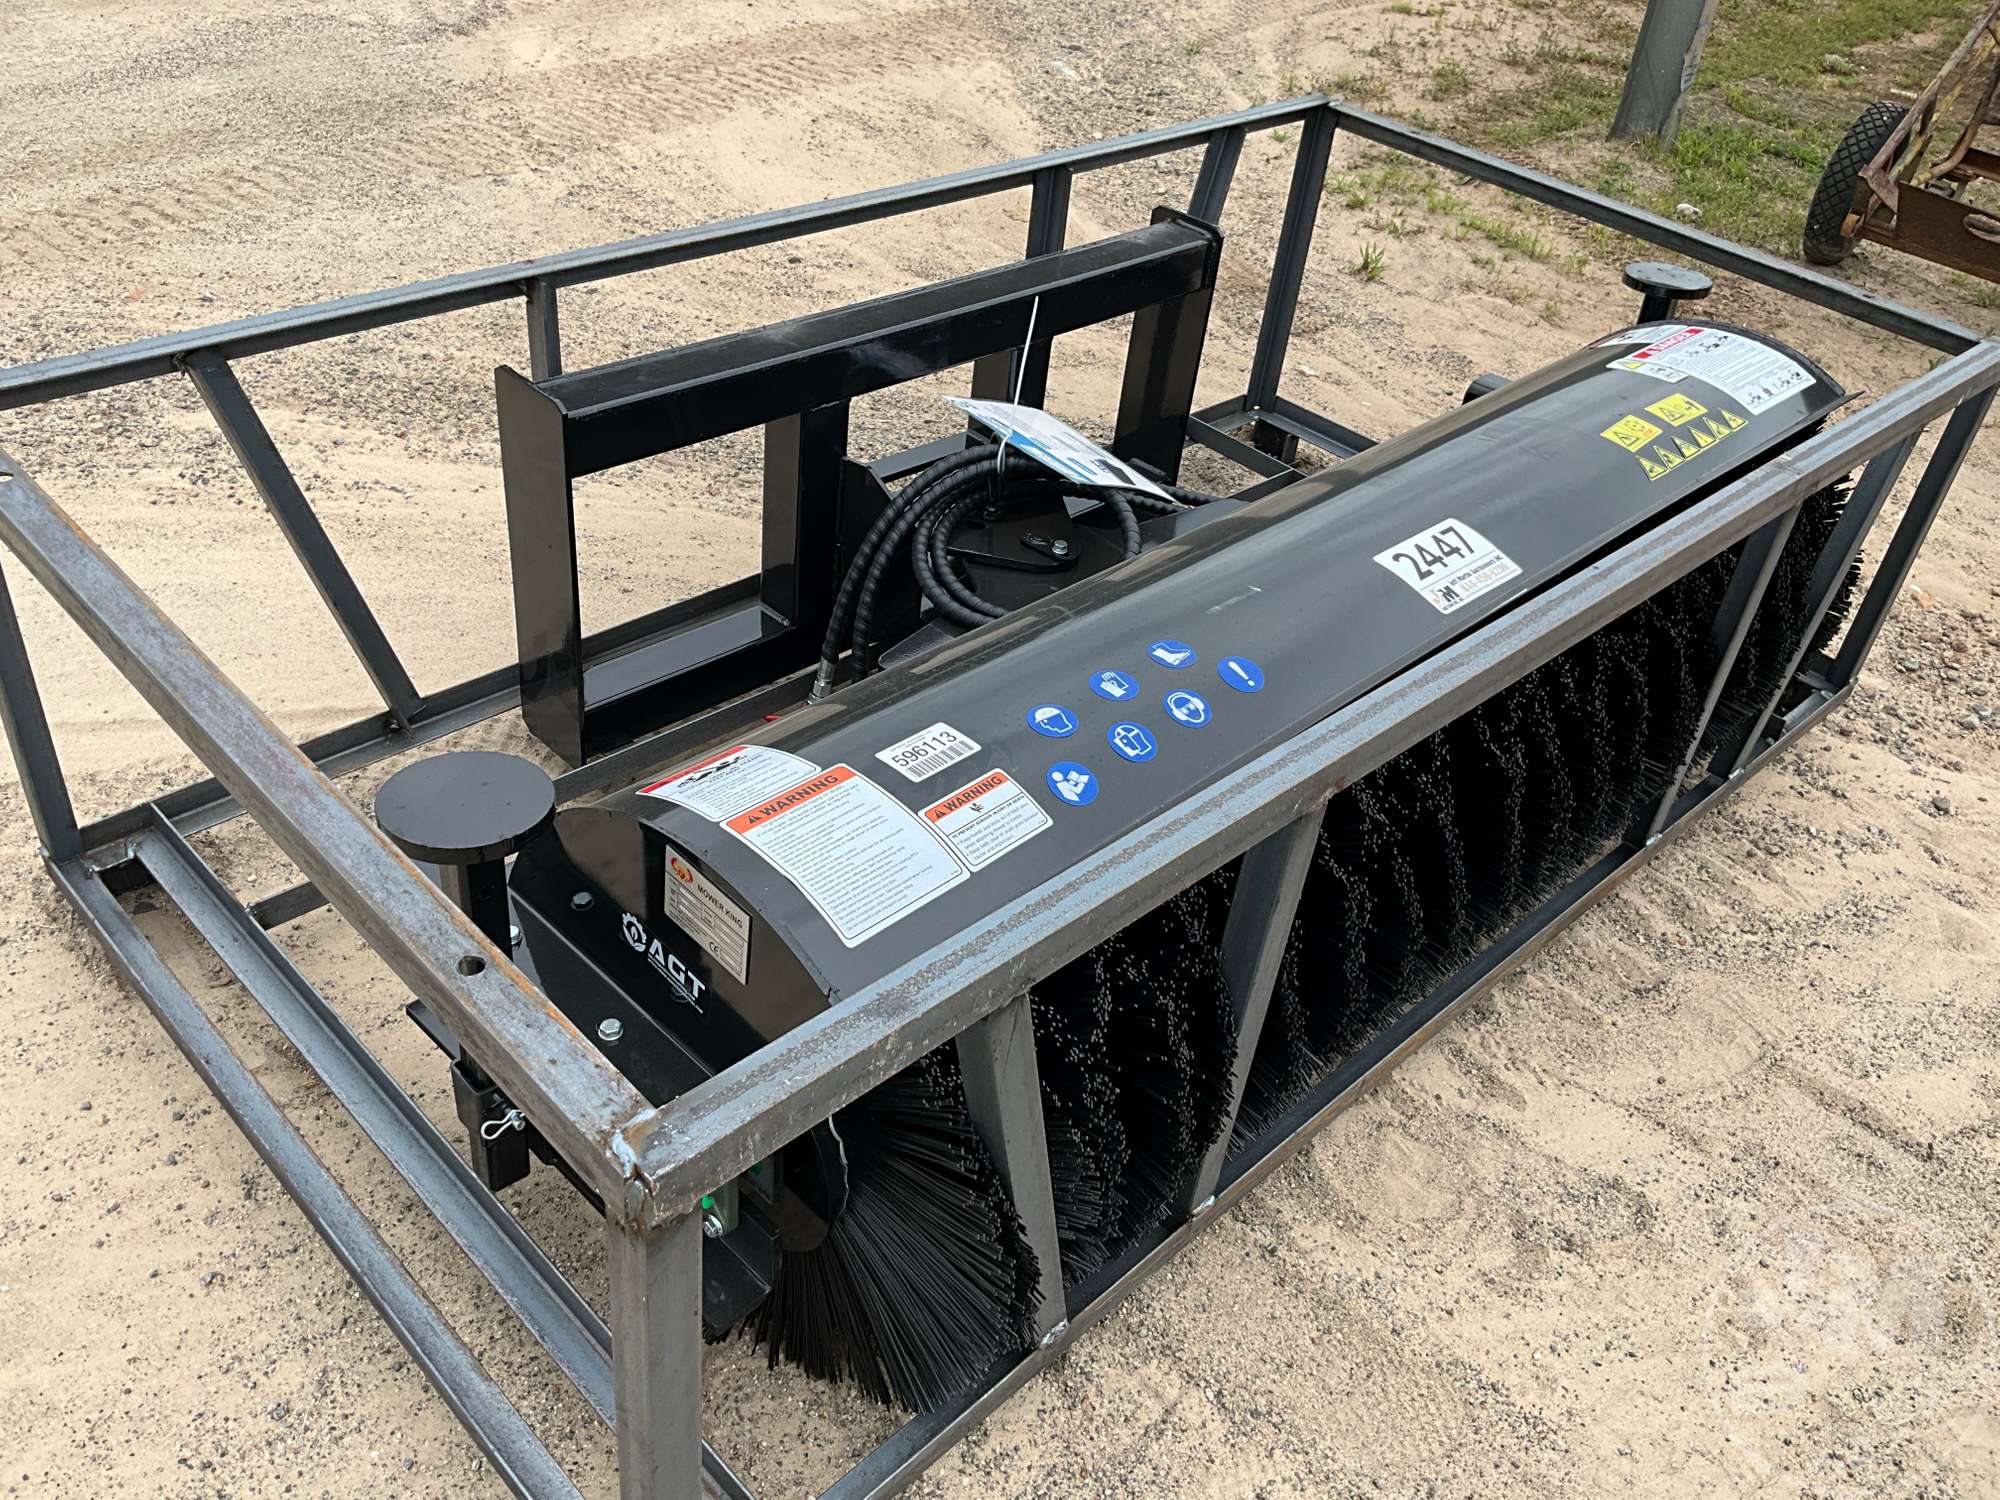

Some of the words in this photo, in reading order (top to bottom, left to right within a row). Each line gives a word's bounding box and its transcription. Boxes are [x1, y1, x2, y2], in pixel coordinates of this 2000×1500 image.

[1392, 526, 1474, 581] 2447
[891, 731, 957, 767] 596113
[759, 774, 839, 816] WARNING
[943, 775, 1002, 811] WARNING
[697, 884, 724, 912] MOWER
[725, 908, 743, 929] KING
[649, 939, 705, 996] AGT
